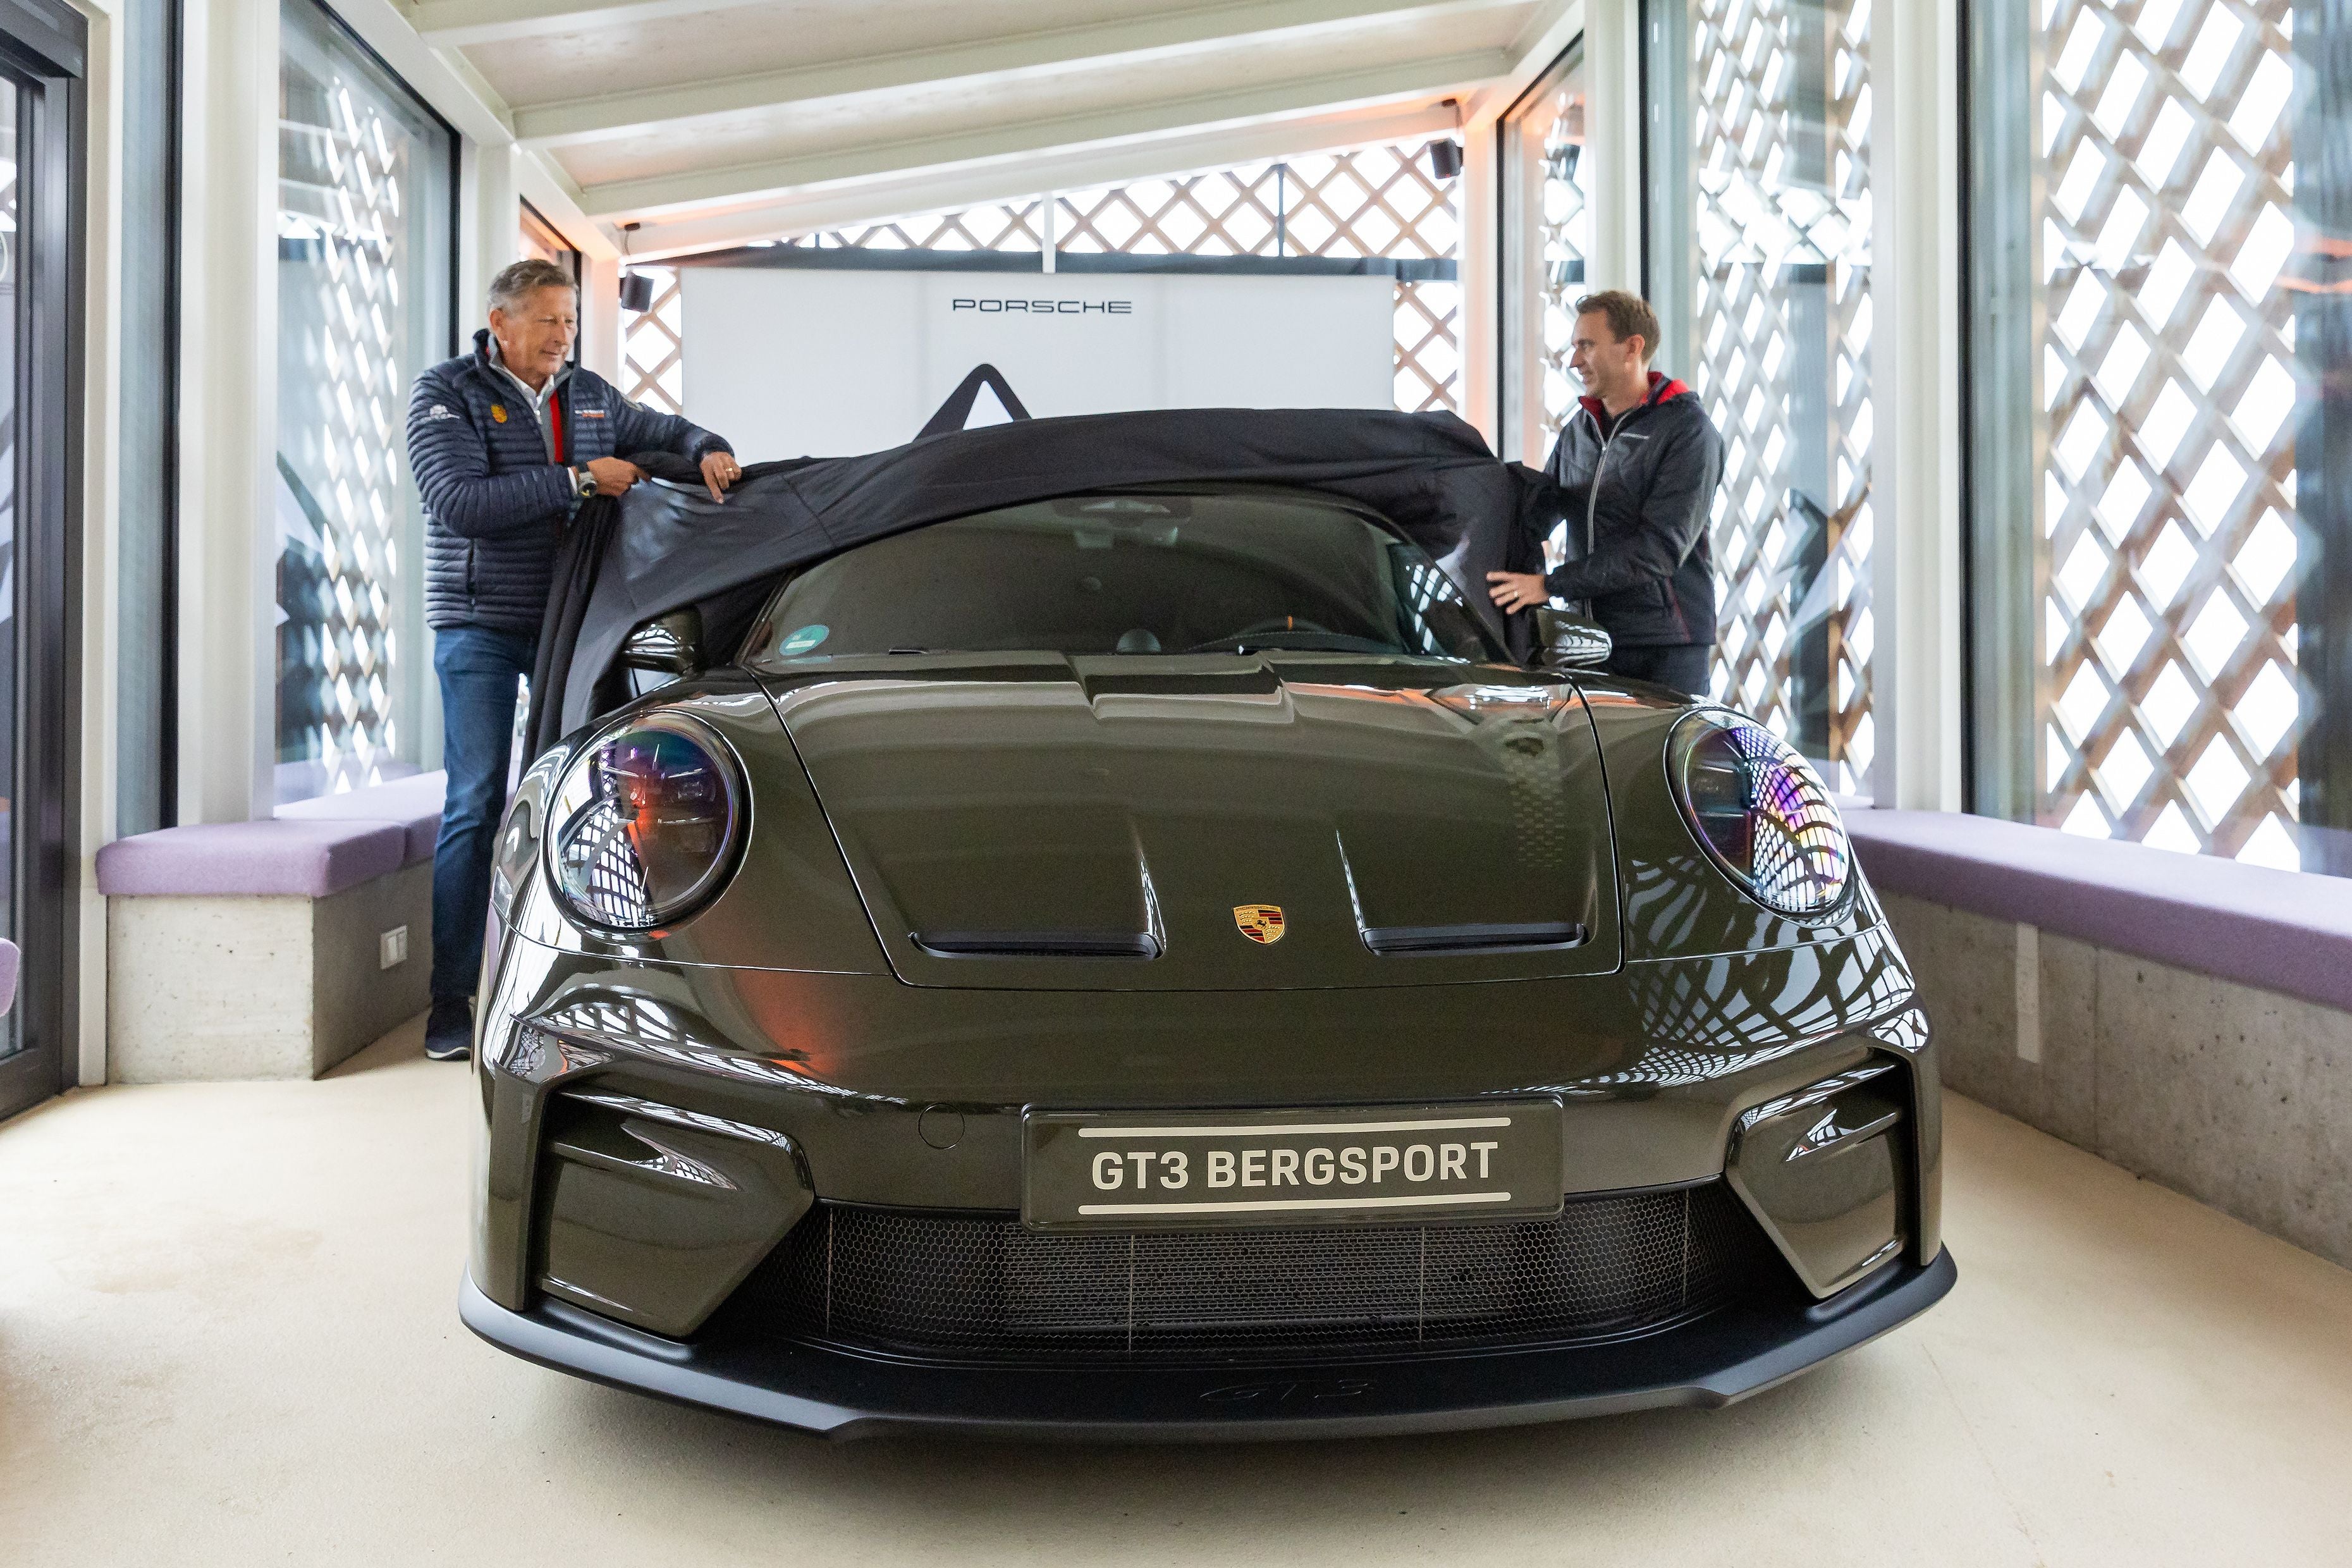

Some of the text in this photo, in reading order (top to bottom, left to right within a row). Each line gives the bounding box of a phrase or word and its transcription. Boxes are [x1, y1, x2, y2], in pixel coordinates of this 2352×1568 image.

[952, 298, 1132, 314] PORSCHE
[1092, 1141, 1498, 1190] GT3 BERGSPORT
